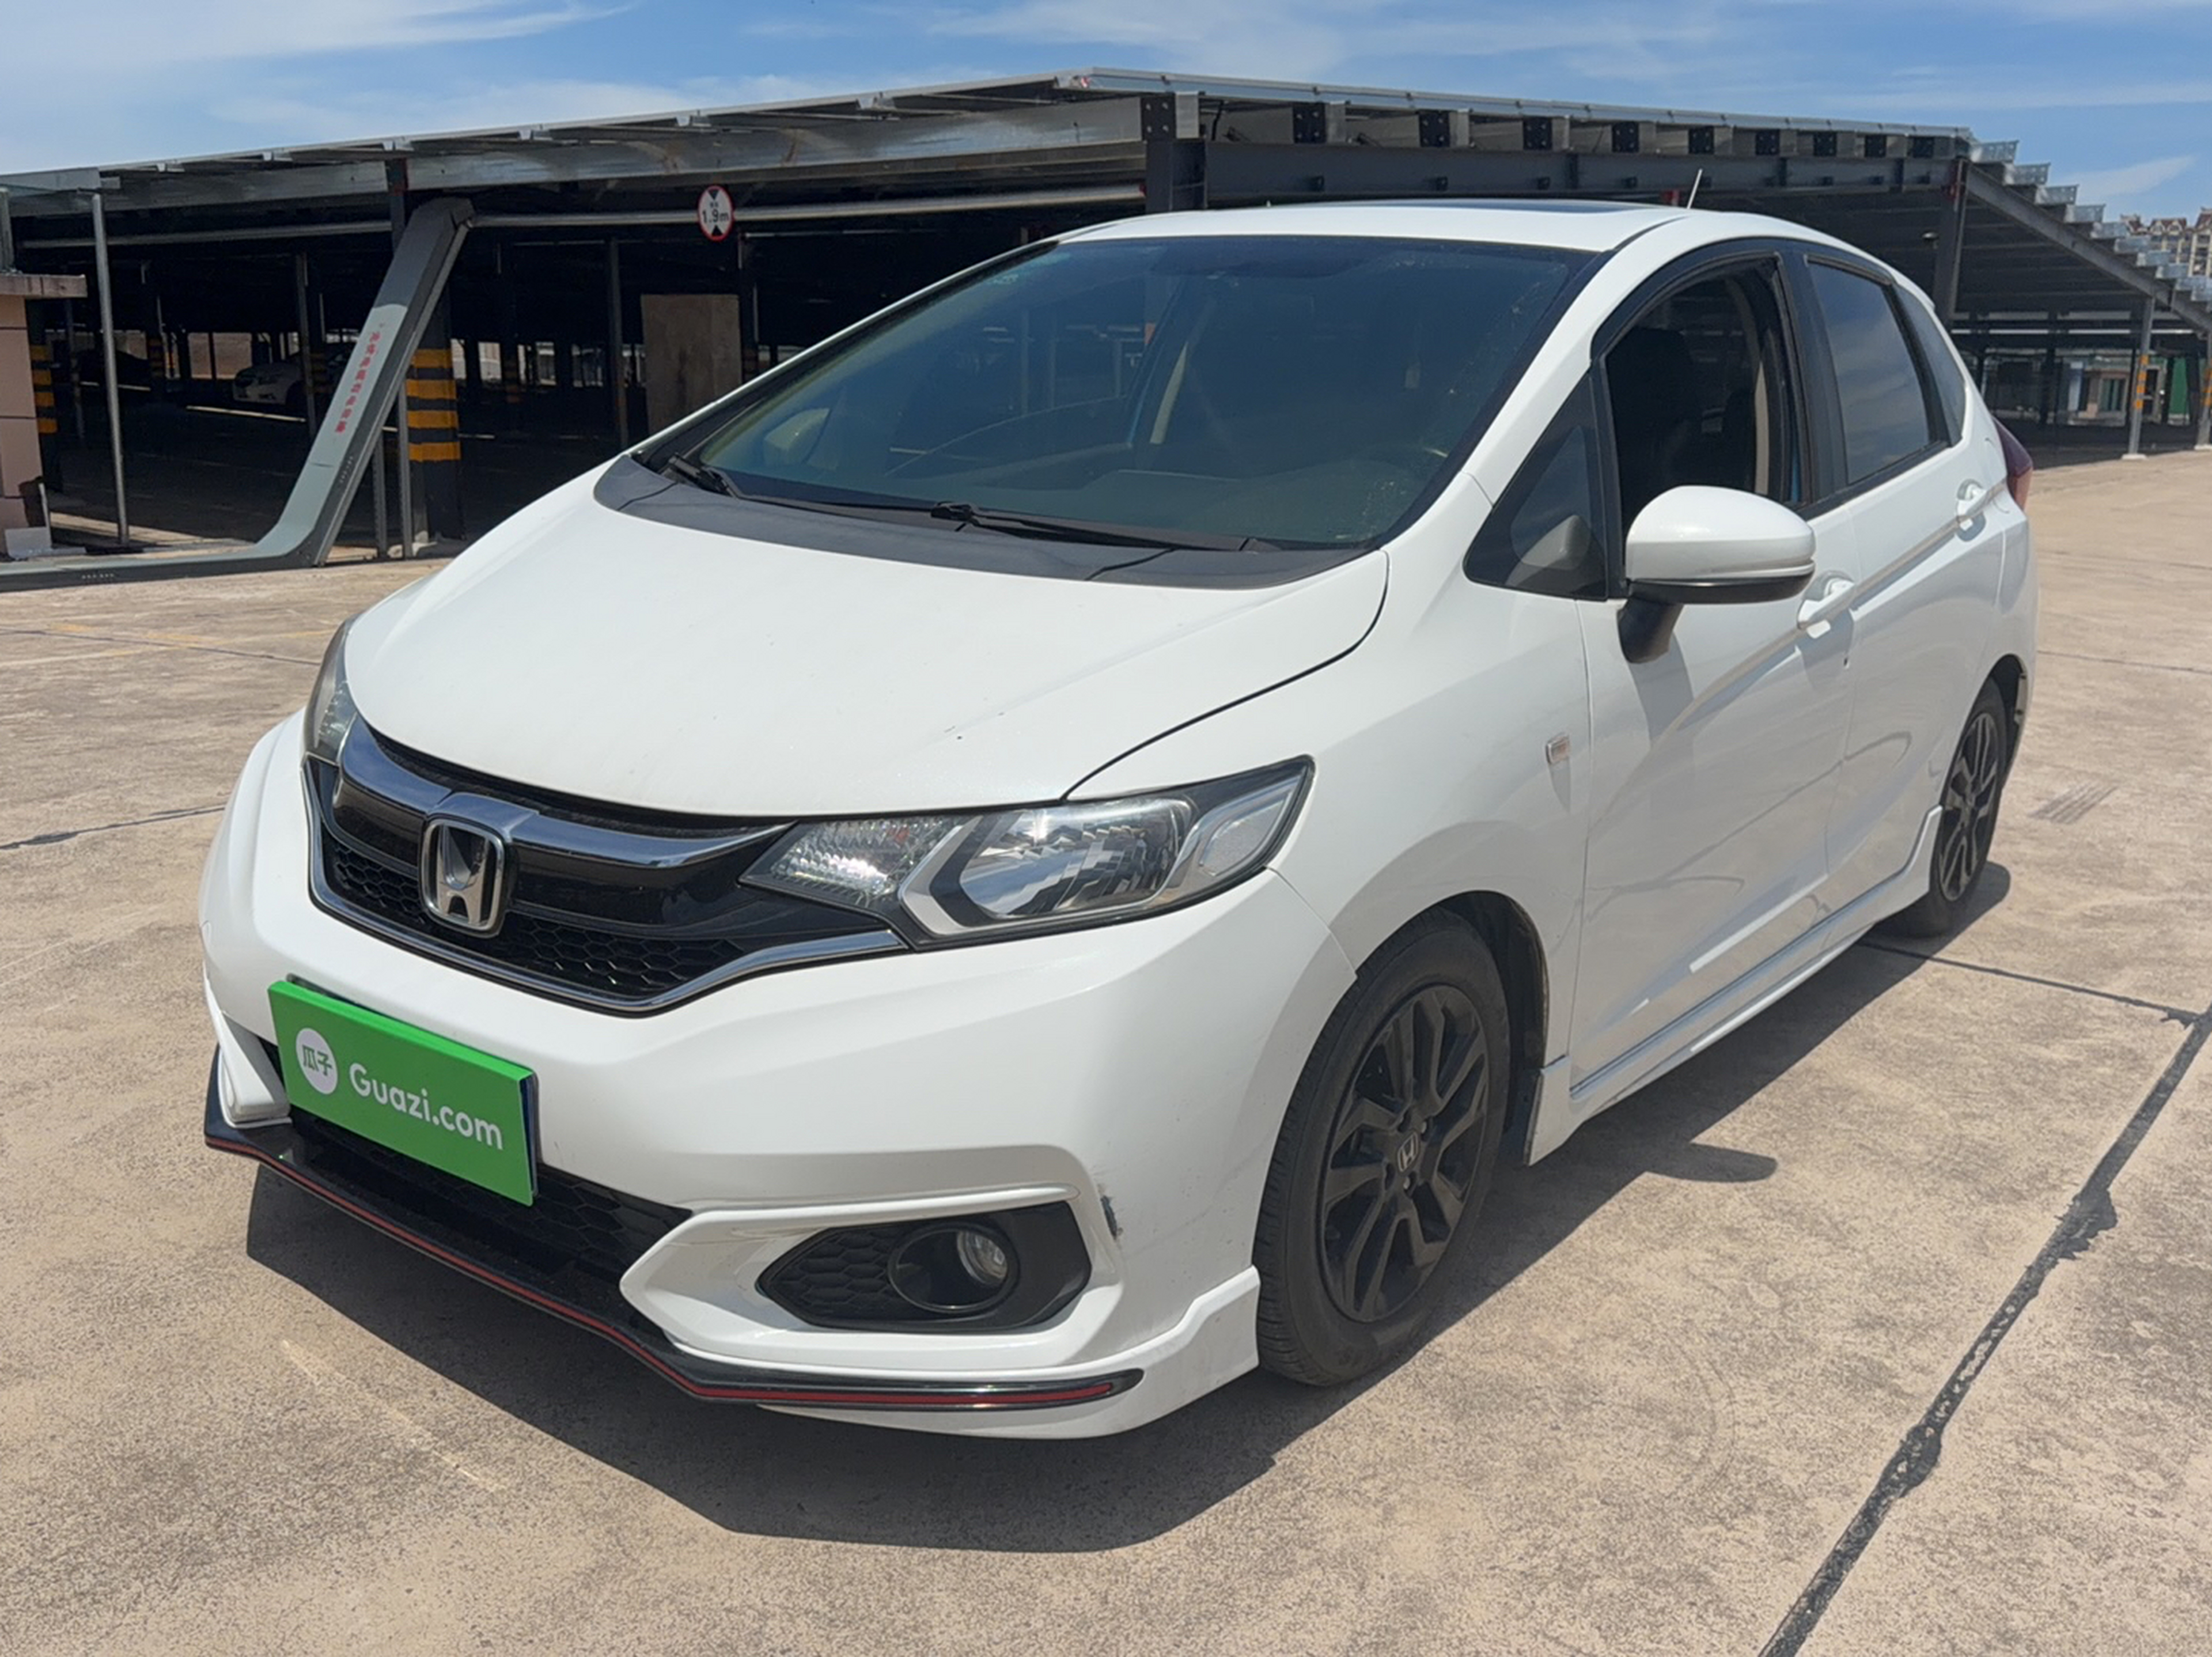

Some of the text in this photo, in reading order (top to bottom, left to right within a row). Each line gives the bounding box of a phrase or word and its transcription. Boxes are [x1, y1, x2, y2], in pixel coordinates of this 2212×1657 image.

[702, 209, 729, 224] 1.9m
[302, 1044, 332, 1077] 瓜子
[349, 1062, 503, 1150] Guazi.com
